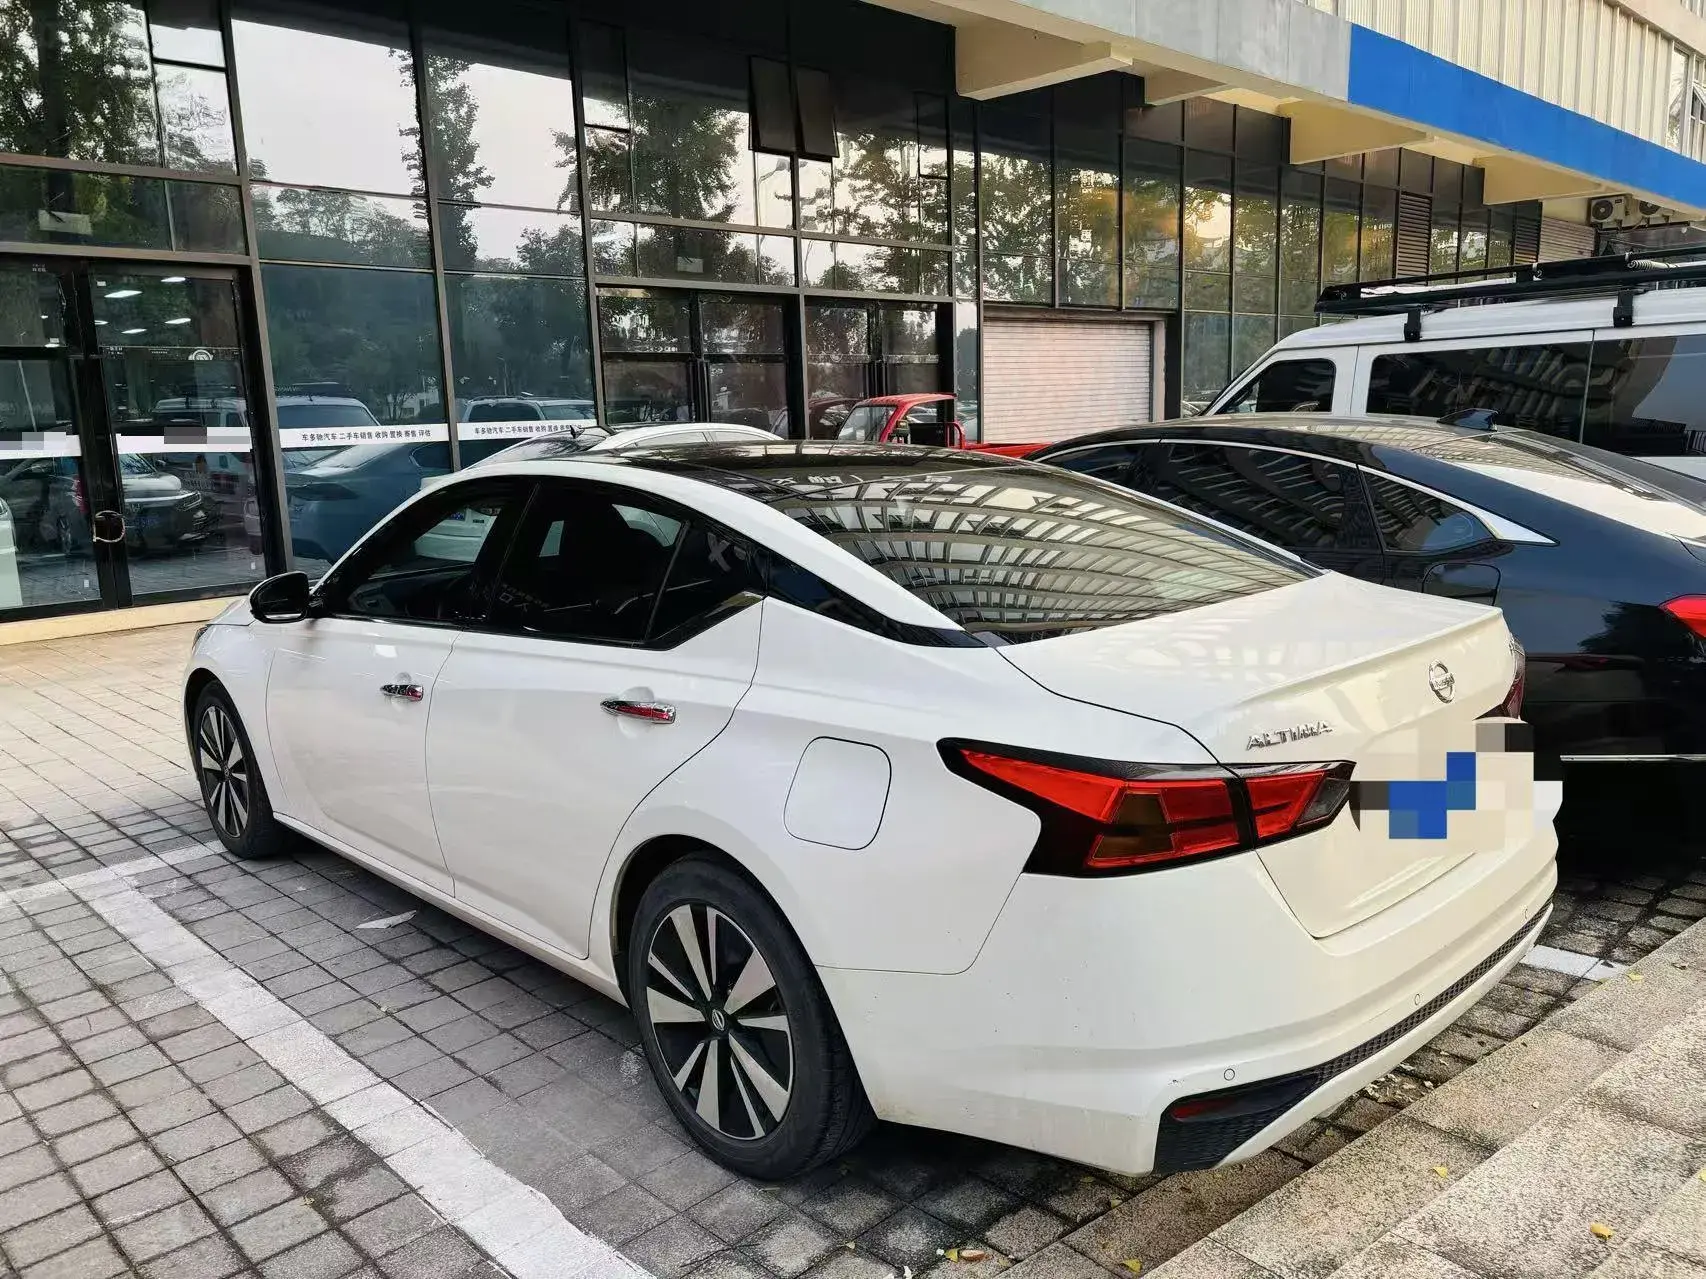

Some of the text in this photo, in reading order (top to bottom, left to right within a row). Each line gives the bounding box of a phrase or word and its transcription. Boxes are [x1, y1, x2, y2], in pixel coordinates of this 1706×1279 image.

[339, 431, 373, 441] 二手车销售
[375, 431, 388, 439] 收购
[389, 430, 403, 438] 置换
[418, 429, 431, 437] 评估
[1246, 720, 1334, 751] ALTIMA
